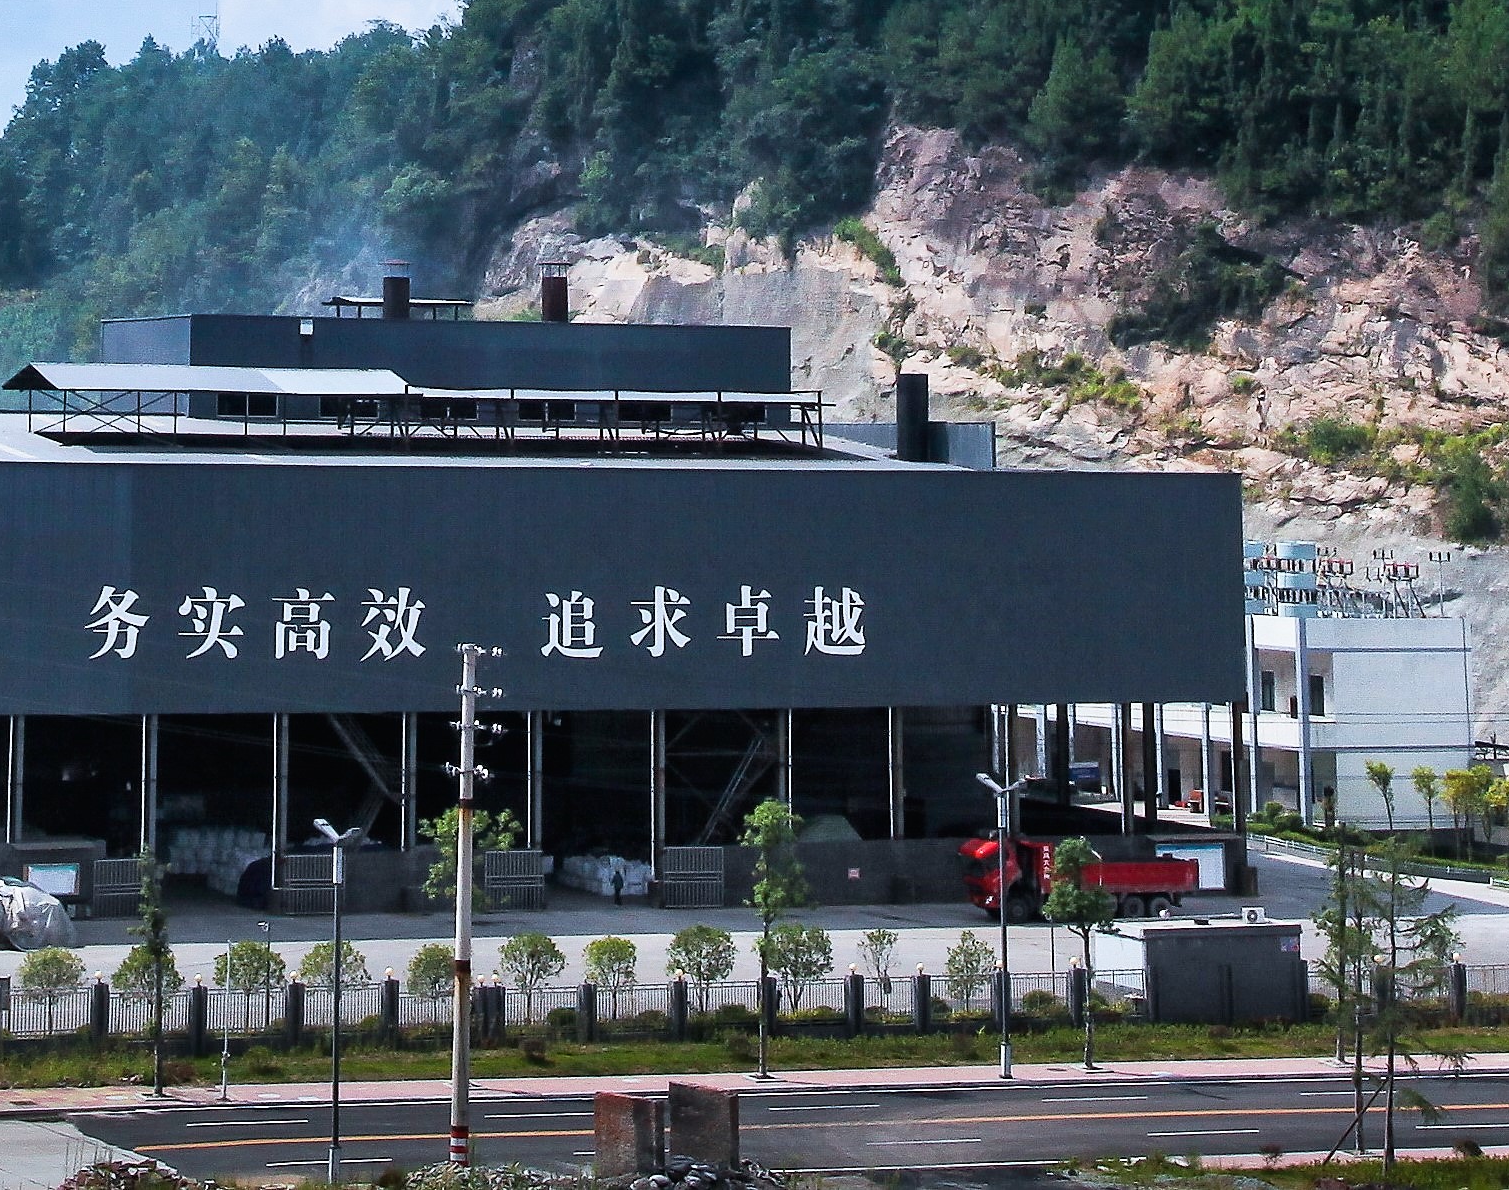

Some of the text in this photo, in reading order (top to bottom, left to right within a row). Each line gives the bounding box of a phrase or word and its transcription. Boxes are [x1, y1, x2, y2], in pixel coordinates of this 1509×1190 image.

[84, 585, 427, 662] 务实高效
[540, 585, 866, 658] 追求卓越
